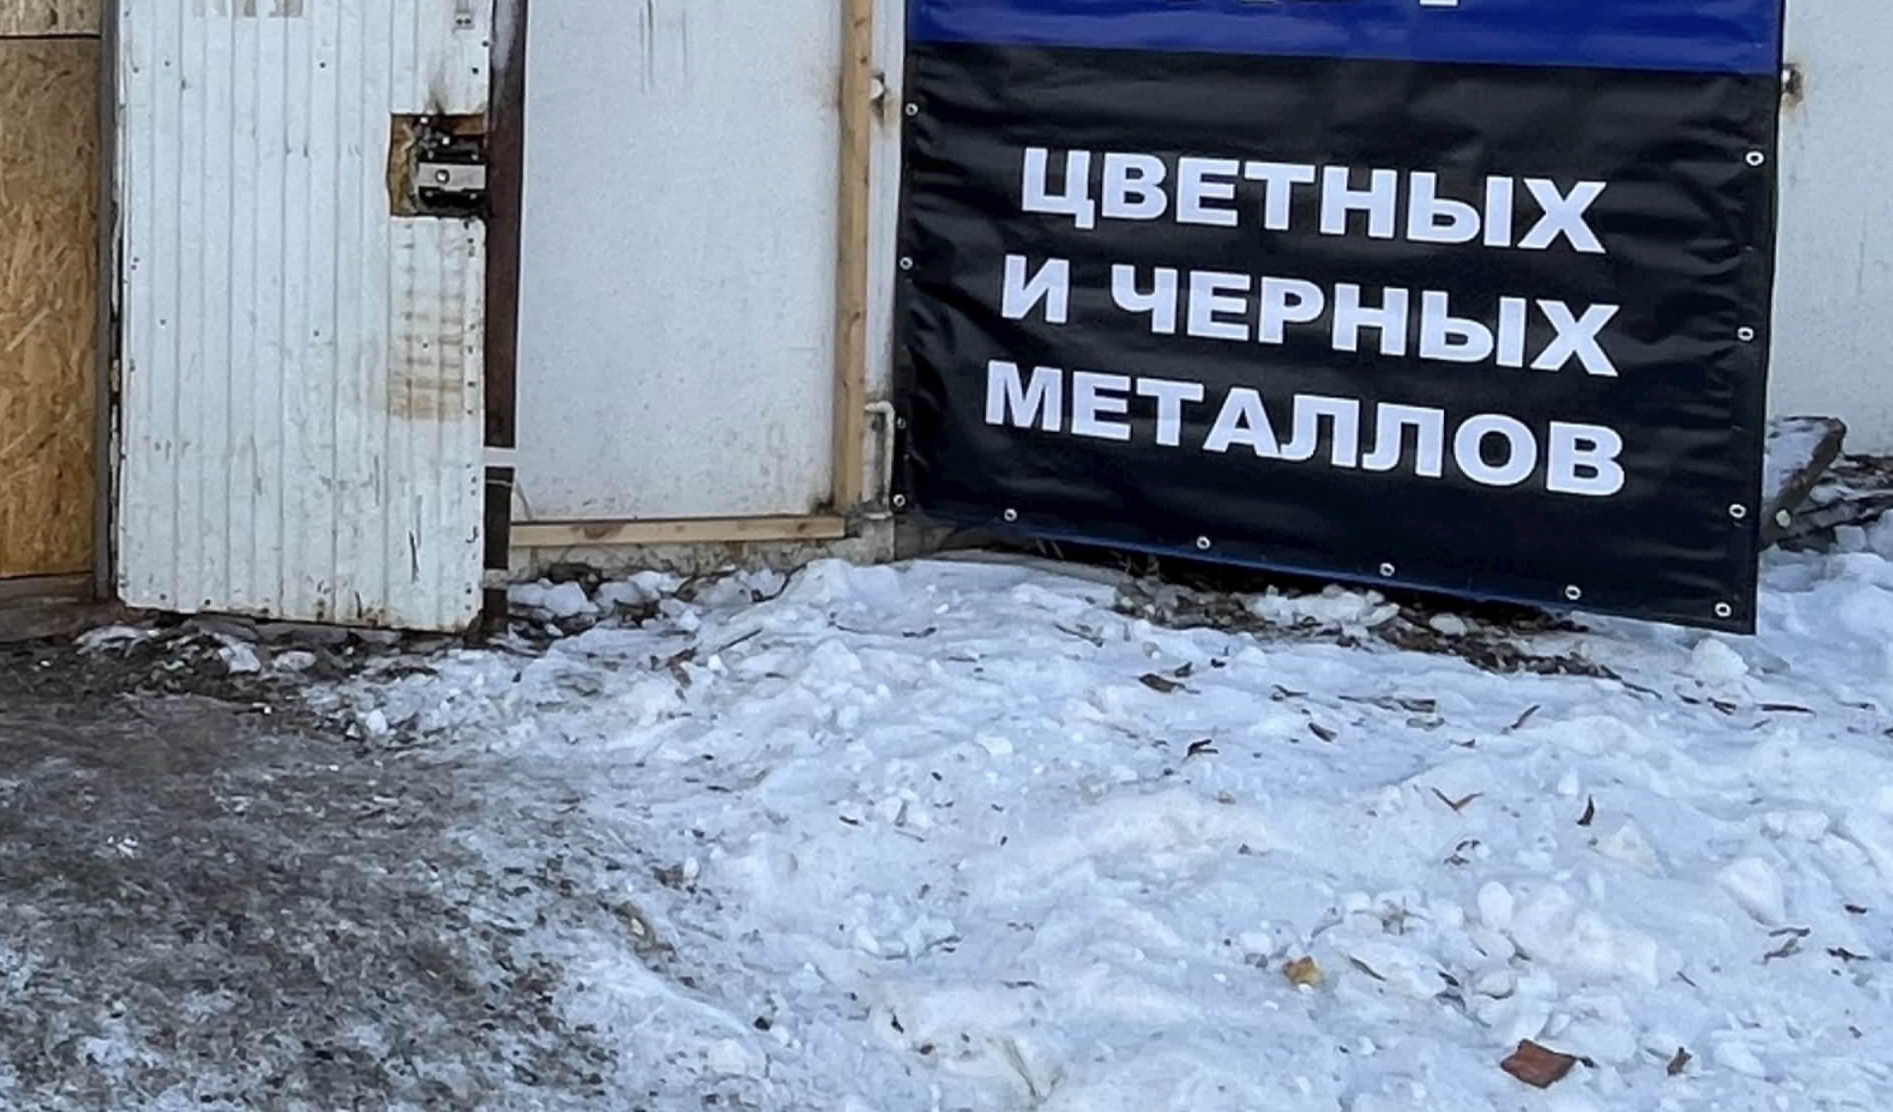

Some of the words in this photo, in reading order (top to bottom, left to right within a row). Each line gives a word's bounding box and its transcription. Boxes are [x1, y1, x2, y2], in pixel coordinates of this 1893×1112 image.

[1021, 147, 1608, 254] ЦВЕТНЫХ
[1001, 254, 1070, 324] И
[1111, 264, 1620, 377] ЧЕРНЫХ
[984, 360, 1626, 497] МЕТАЛЛОВ
